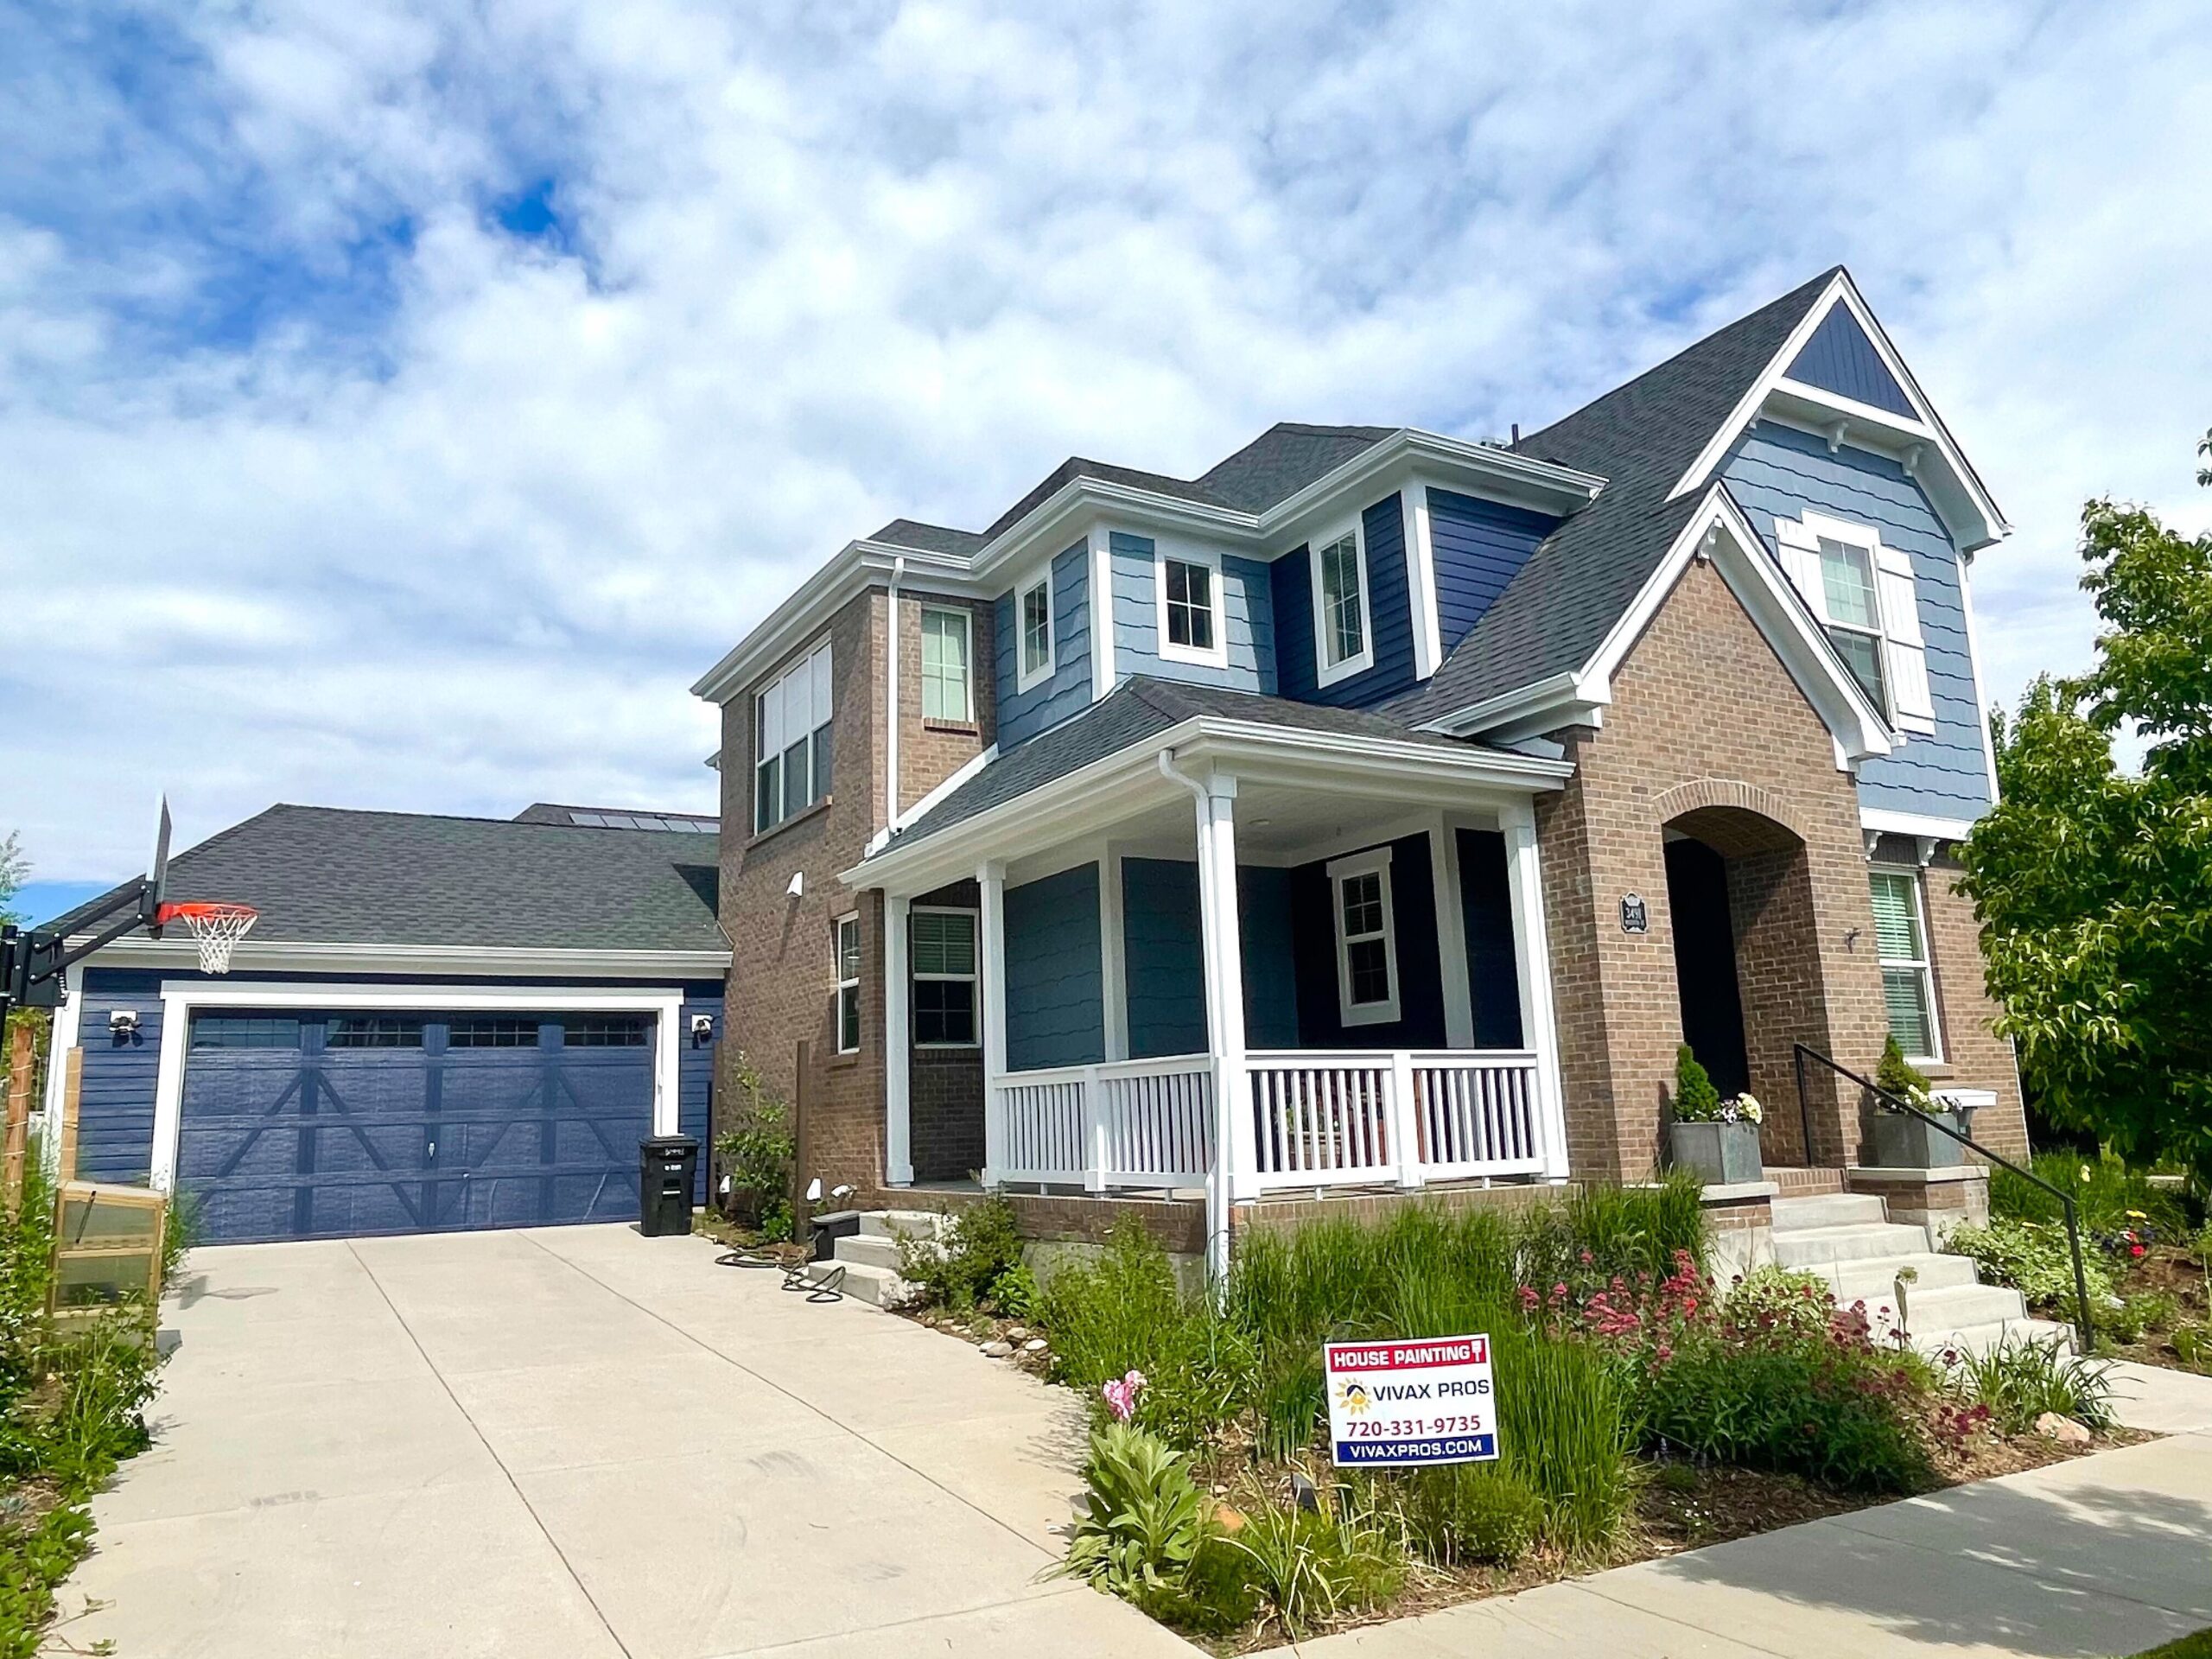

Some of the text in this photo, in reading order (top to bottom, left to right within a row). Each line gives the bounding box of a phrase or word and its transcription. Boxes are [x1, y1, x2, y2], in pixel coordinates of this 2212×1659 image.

[1333, 1345, 1471, 1368] HOUSE PAINTING
[1373, 1379, 1490, 1402] VIVAX PROS
[1346, 1415, 1481, 1437] 720-331-9735
[1350, 1440, 1482, 1459] VIVAXPROS.COM
